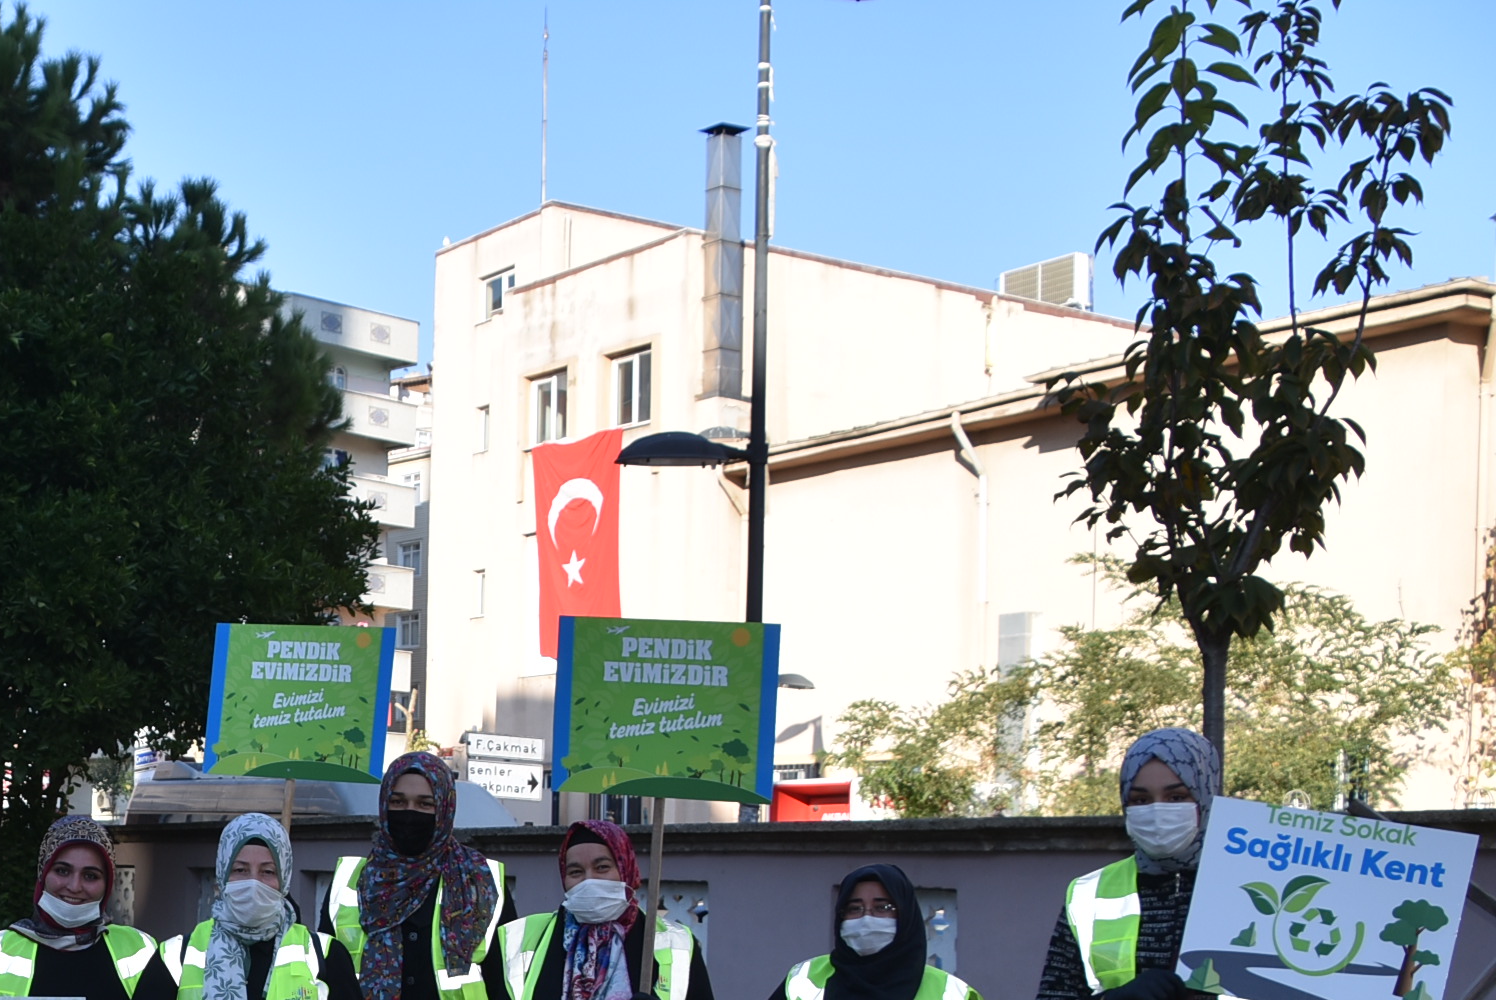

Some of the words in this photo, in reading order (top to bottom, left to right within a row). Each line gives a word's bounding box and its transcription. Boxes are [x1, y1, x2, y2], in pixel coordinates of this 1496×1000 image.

[272, 688, 325, 710] Evimizi
[631, 693, 696, 717] Evimizi
[253, 711, 291, 729] temiz
[293, 703, 347, 723] tutalım
[608, 720, 656, 740] temiz
[658, 711, 724, 733] tutalım
[1266, 803, 1335, 833] Temiz
[1339, 815, 1418, 847] Sokak
[1223, 827, 1353, 872] Sağlıklı
[1359, 848, 1446, 888] Kent
